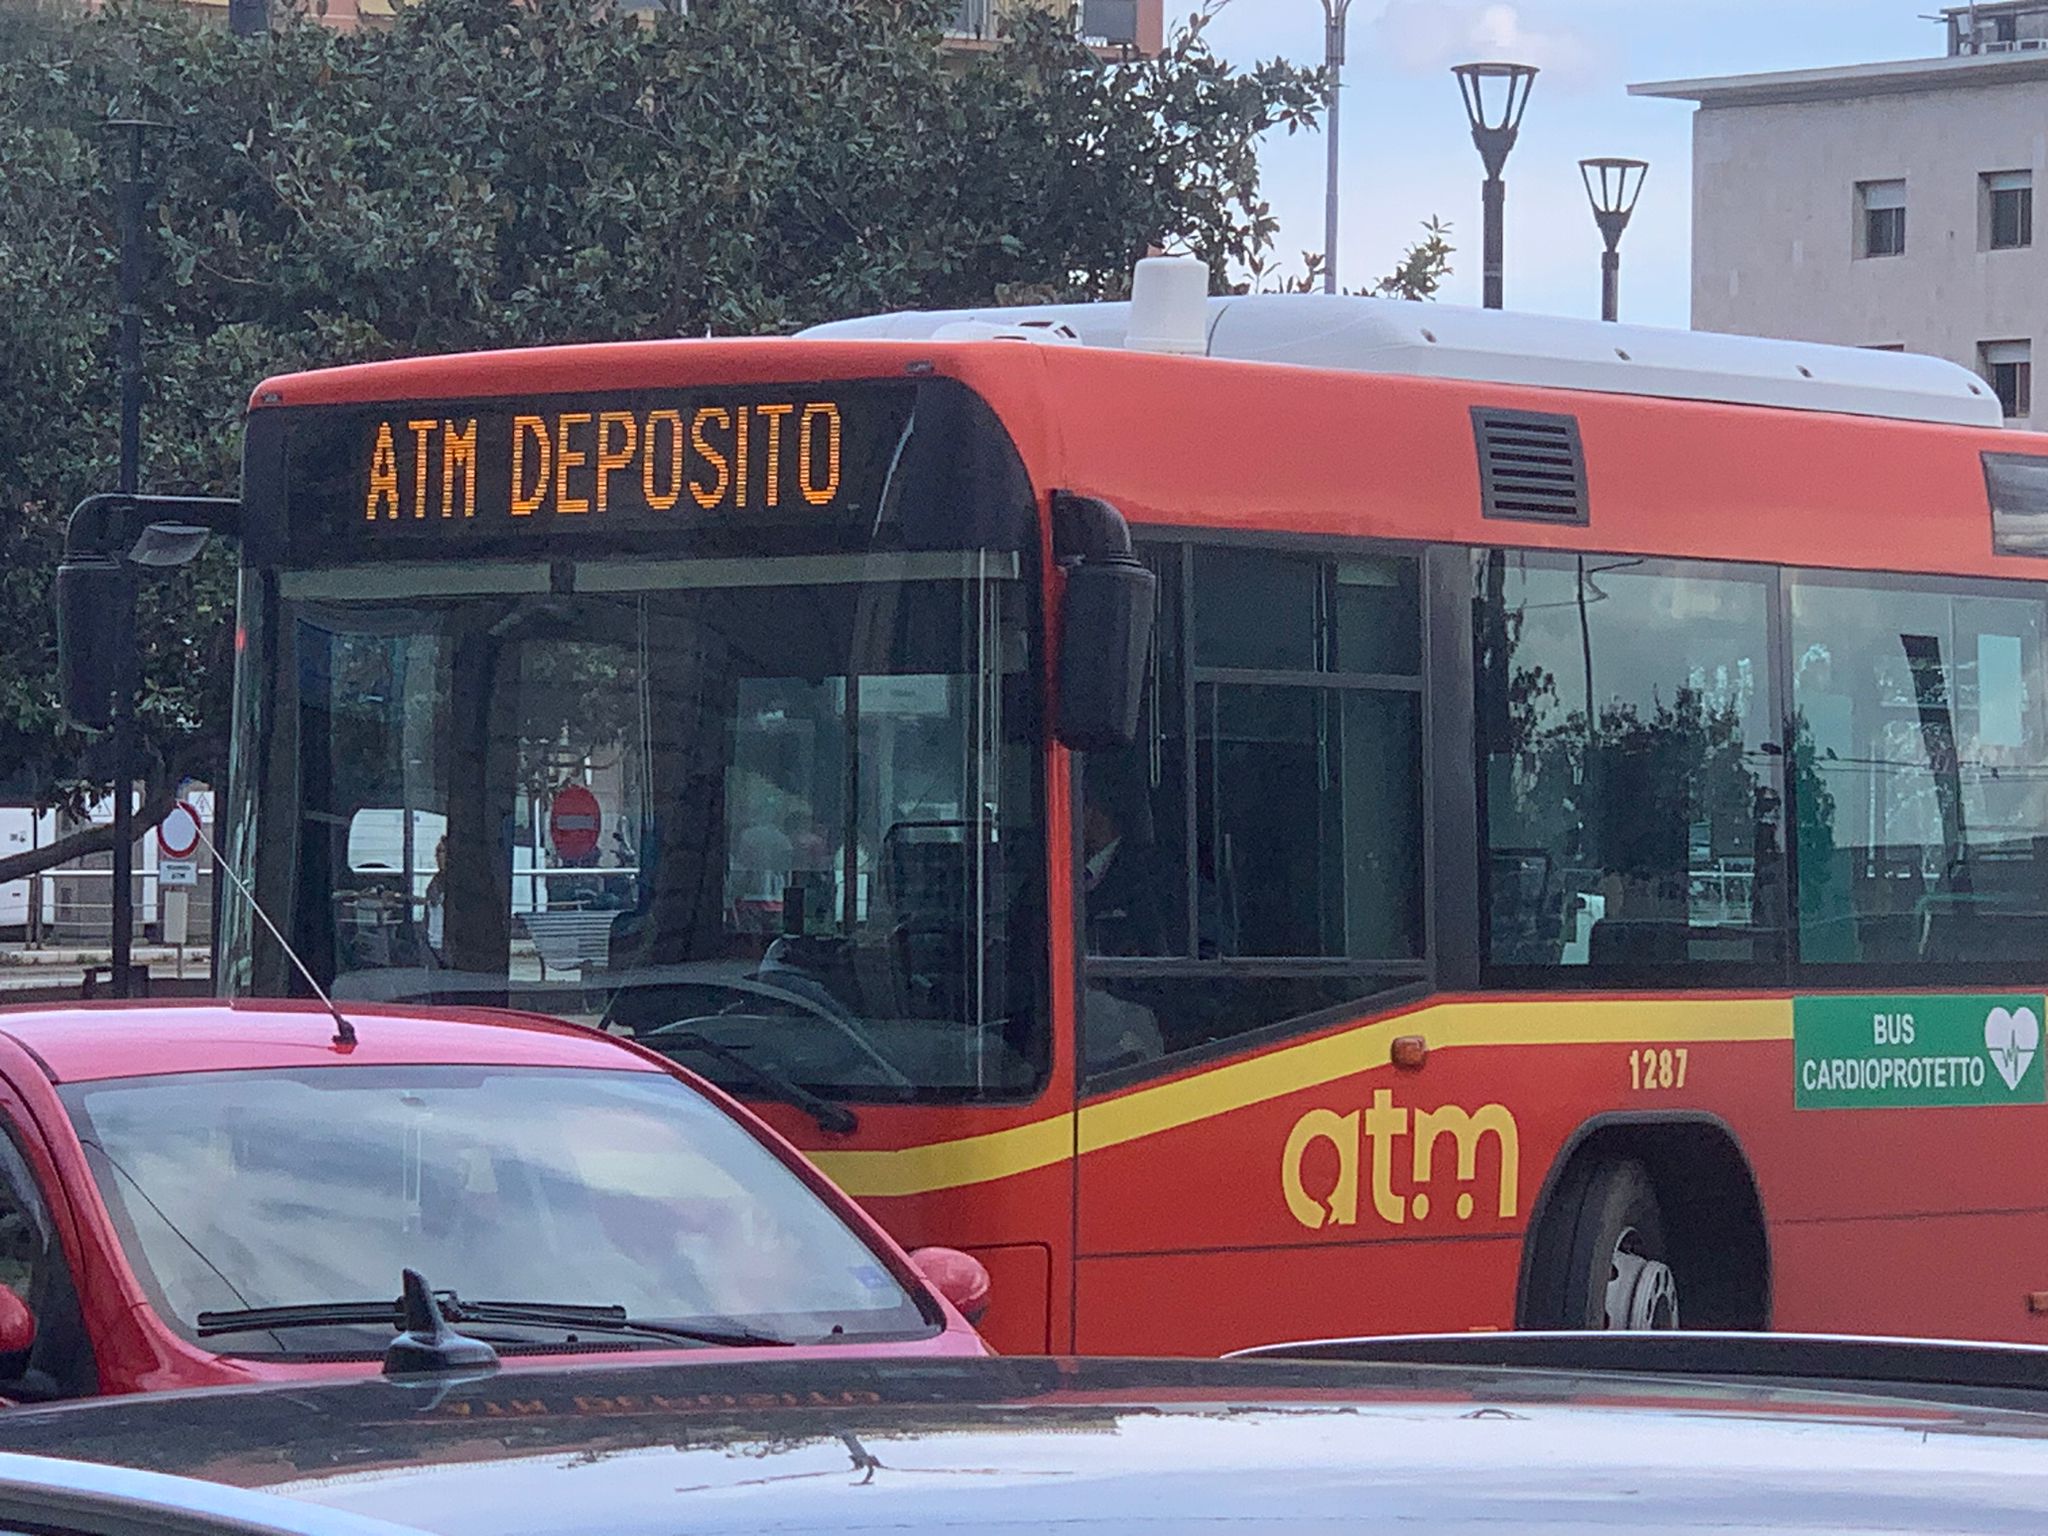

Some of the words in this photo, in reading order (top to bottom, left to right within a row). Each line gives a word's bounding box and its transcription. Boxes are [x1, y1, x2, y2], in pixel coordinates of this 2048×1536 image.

[366, 418, 477, 520] ATM
[510, 403, 841, 516] DEPOSITO
[1873, 1014, 1915, 1045] BUS
[1629, 1049, 1688, 1090] 1287
[1803, 1057, 1985, 1091] CARDIOPROTETTO
[1281, 1089, 1519, 1230] atm
